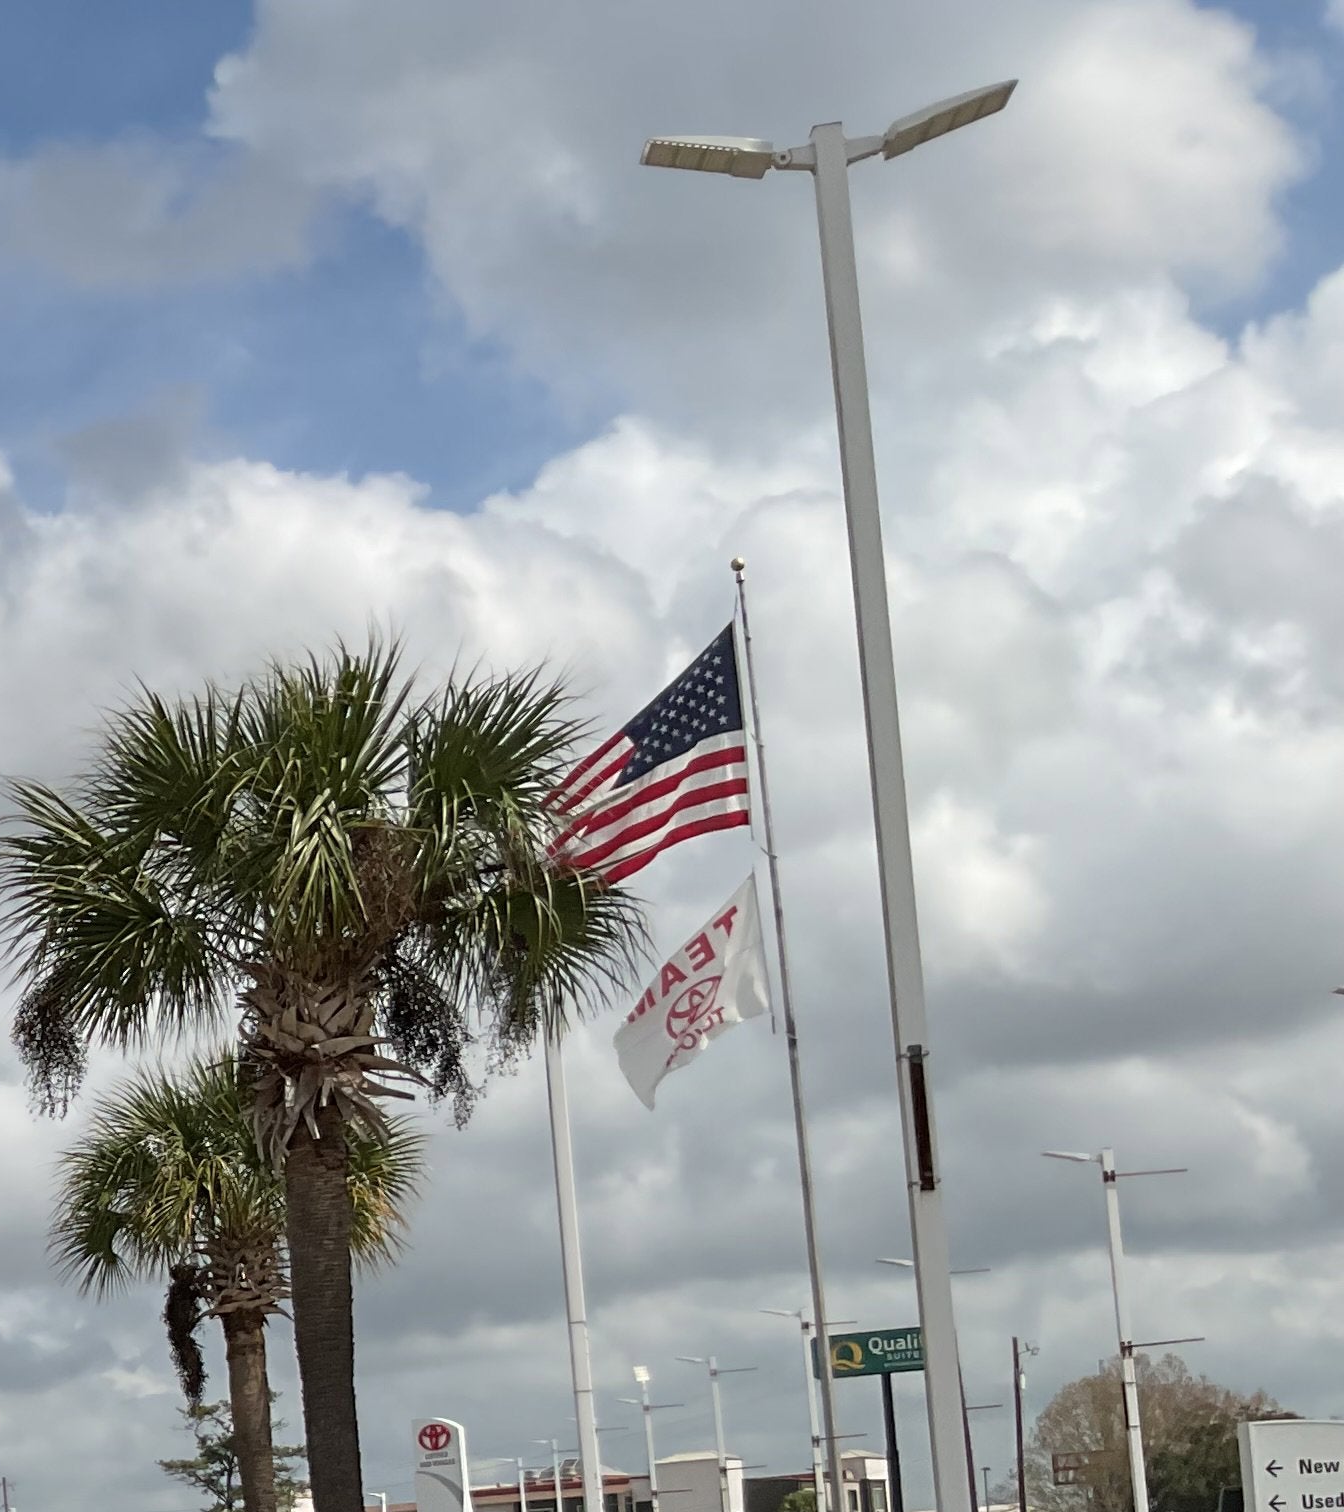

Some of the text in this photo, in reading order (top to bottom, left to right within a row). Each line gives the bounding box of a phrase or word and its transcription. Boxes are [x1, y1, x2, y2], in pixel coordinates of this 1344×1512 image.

[868, 1333, 920, 1355] Quali
[886, 1350, 920, 1361] SUITE
[1299, 1458, 1340, 1475] New
[1301, 1492, 1344, 1510] Used
